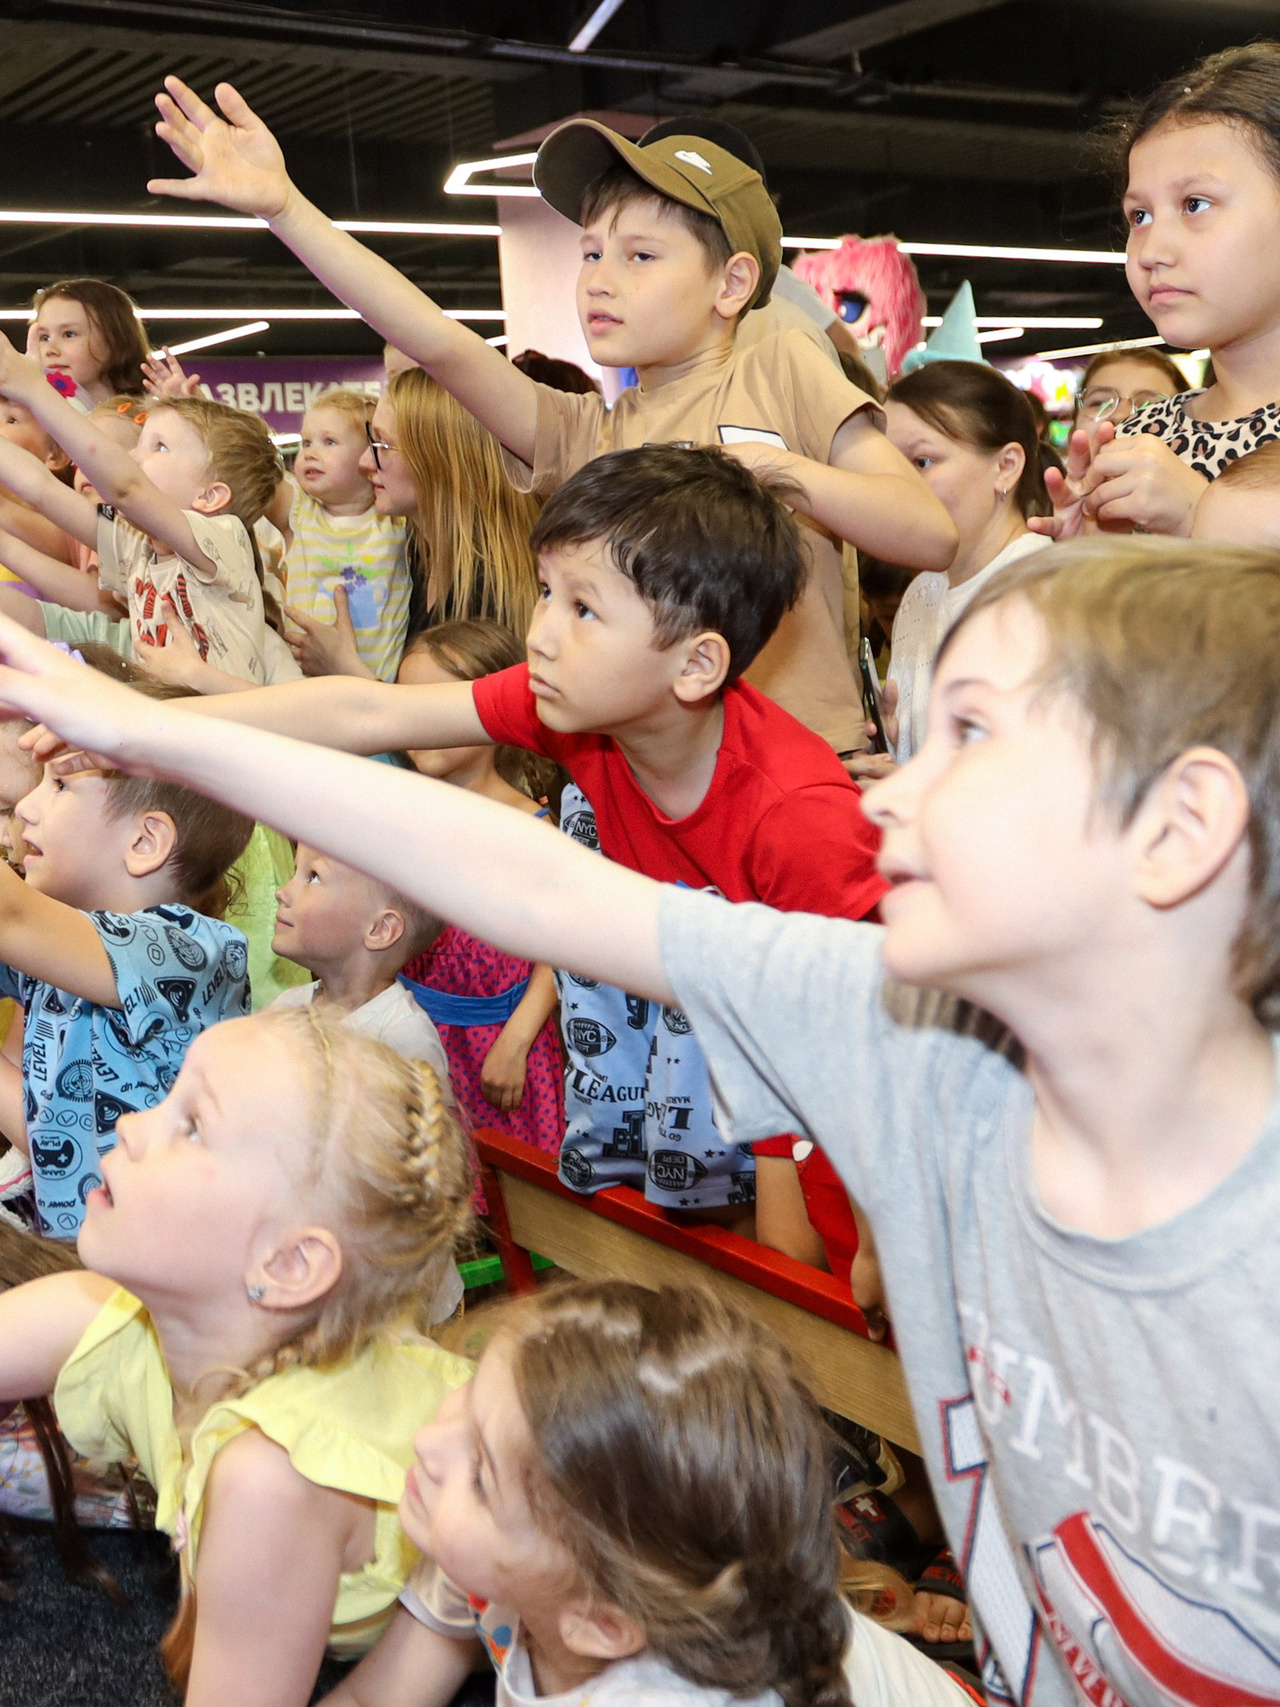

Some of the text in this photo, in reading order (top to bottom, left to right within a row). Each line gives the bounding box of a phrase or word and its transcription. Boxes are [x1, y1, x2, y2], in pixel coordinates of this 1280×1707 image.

[575, 820, 597, 837] NYC
[32, 1043, 48, 1082] LEVEL
[40, 1168, 66, 1177] GAME
[657, 1165, 685, 1180] NYC
[47, 1198, 77, 1209] power
